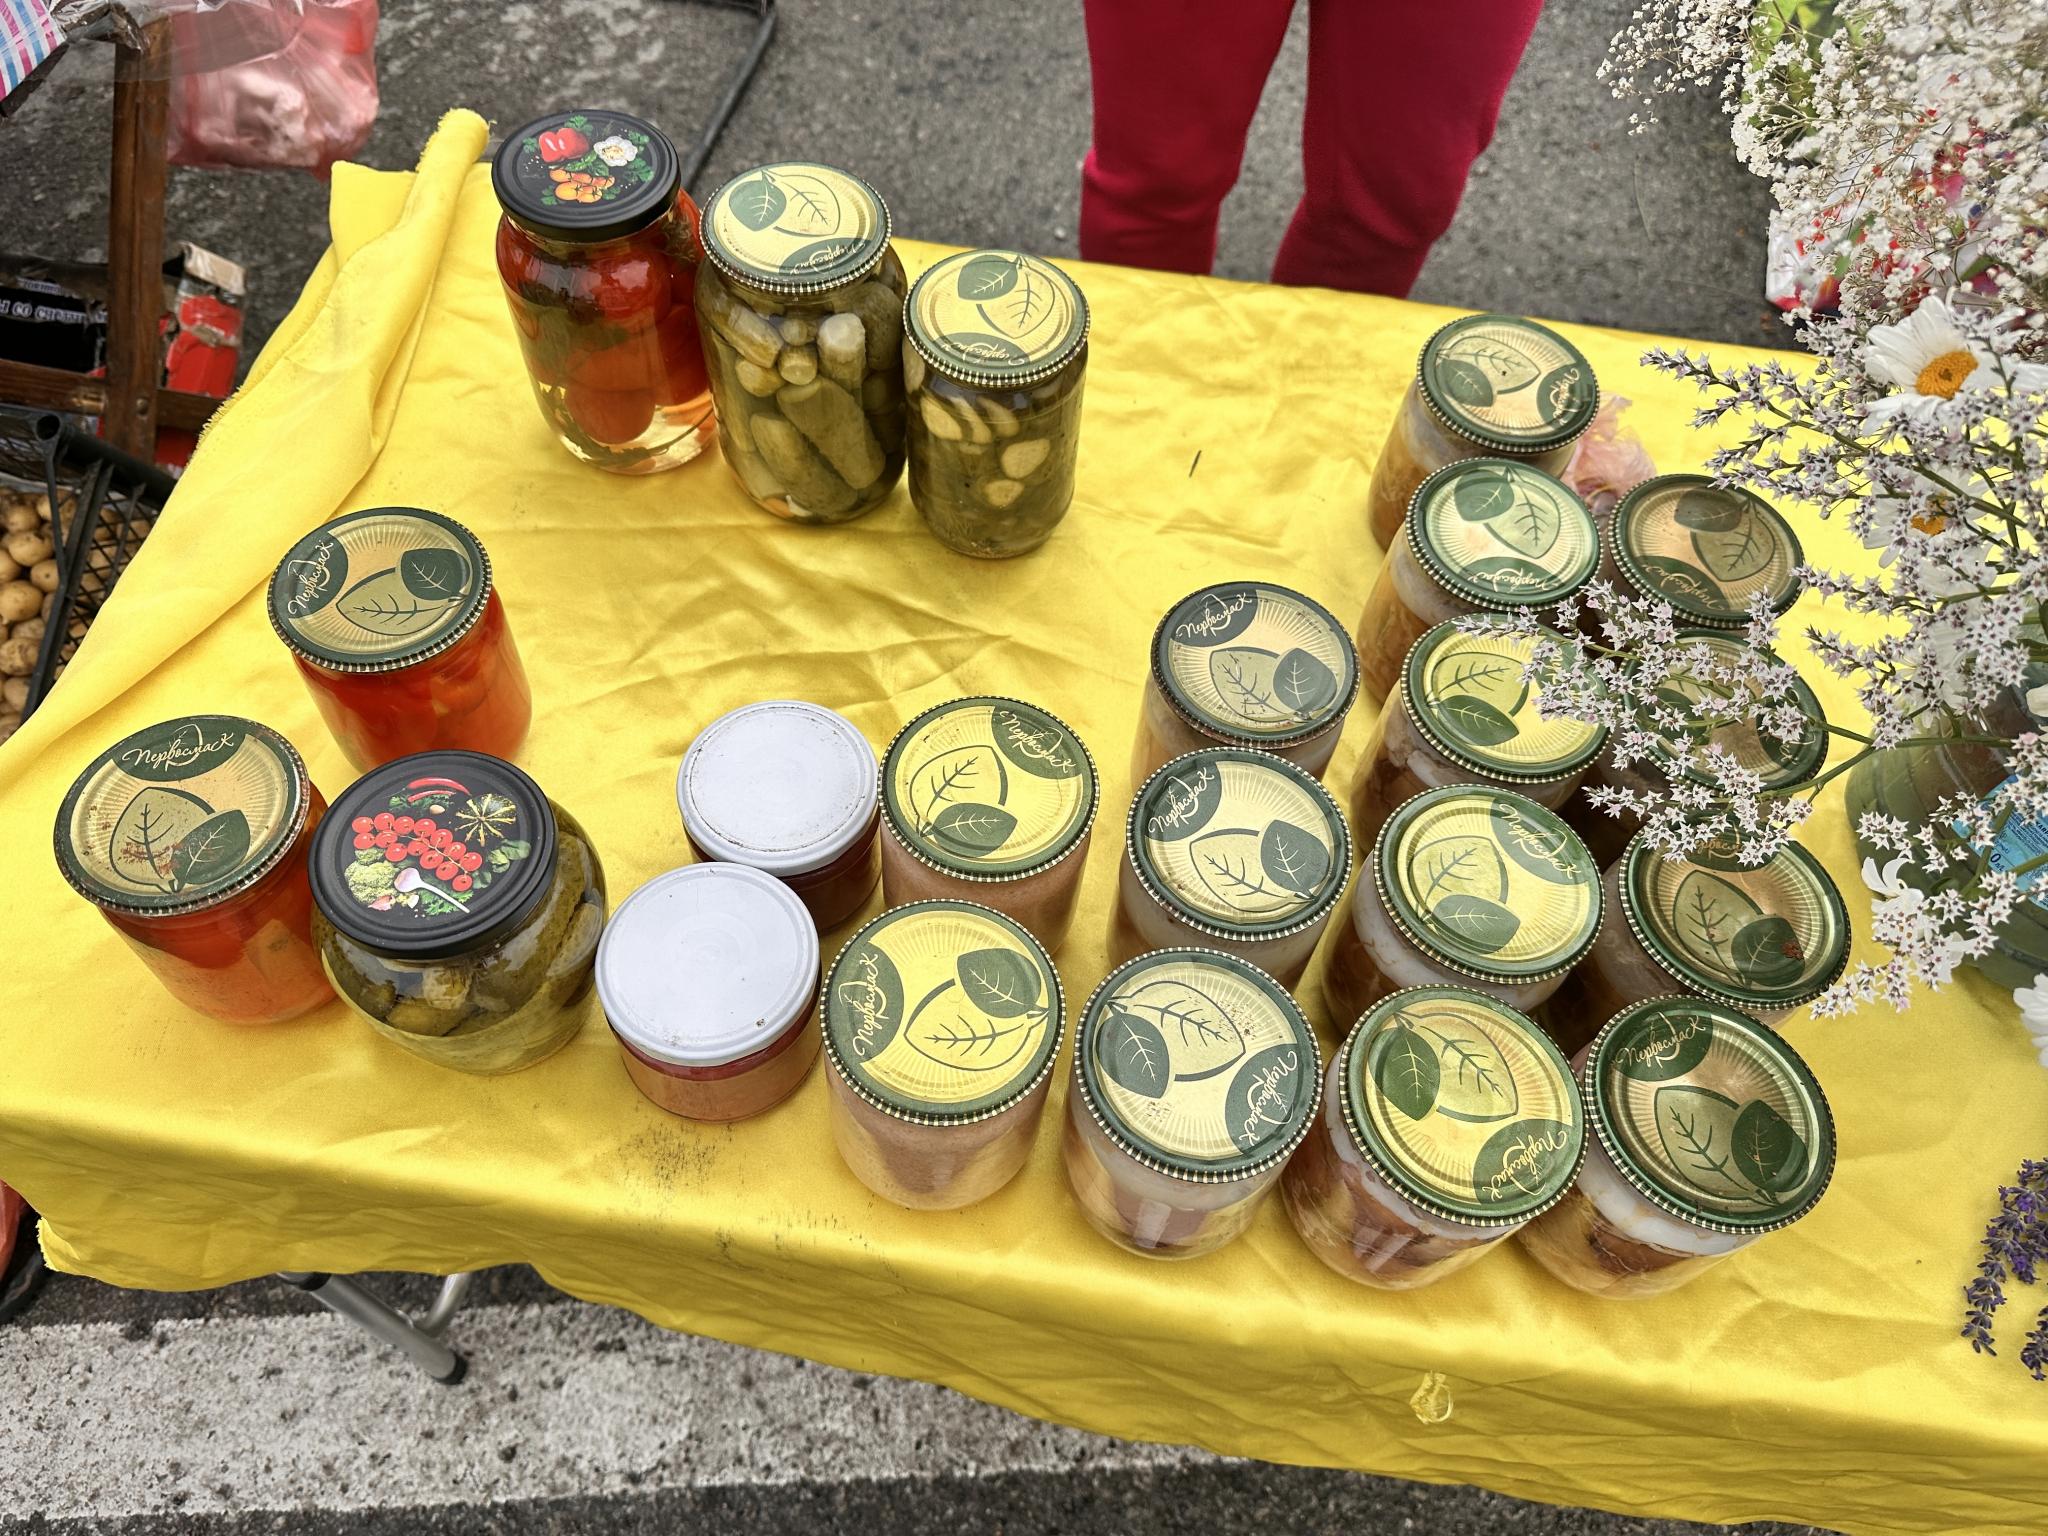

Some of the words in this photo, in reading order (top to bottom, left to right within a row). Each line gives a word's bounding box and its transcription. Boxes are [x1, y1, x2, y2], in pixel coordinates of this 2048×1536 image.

[288, 540, 334, 615] Первосмак
[1176, 592, 1253, 639] Первосмак
[122, 731, 235, 770] Первосмак
[1000, 710, 1077, 774] Первосмак
[1148, 766, 1215, 833] Первосмак
[1499, 803, 1581, 880] Первосмак
[851, 952, 886, 1057] Первосмак
[1612, 1014, 1707, 1069] Первосмак
[1239, 1050, 1298, 1147] Первосмак
[1482, 1130, 1568, 1202] Первосмак
